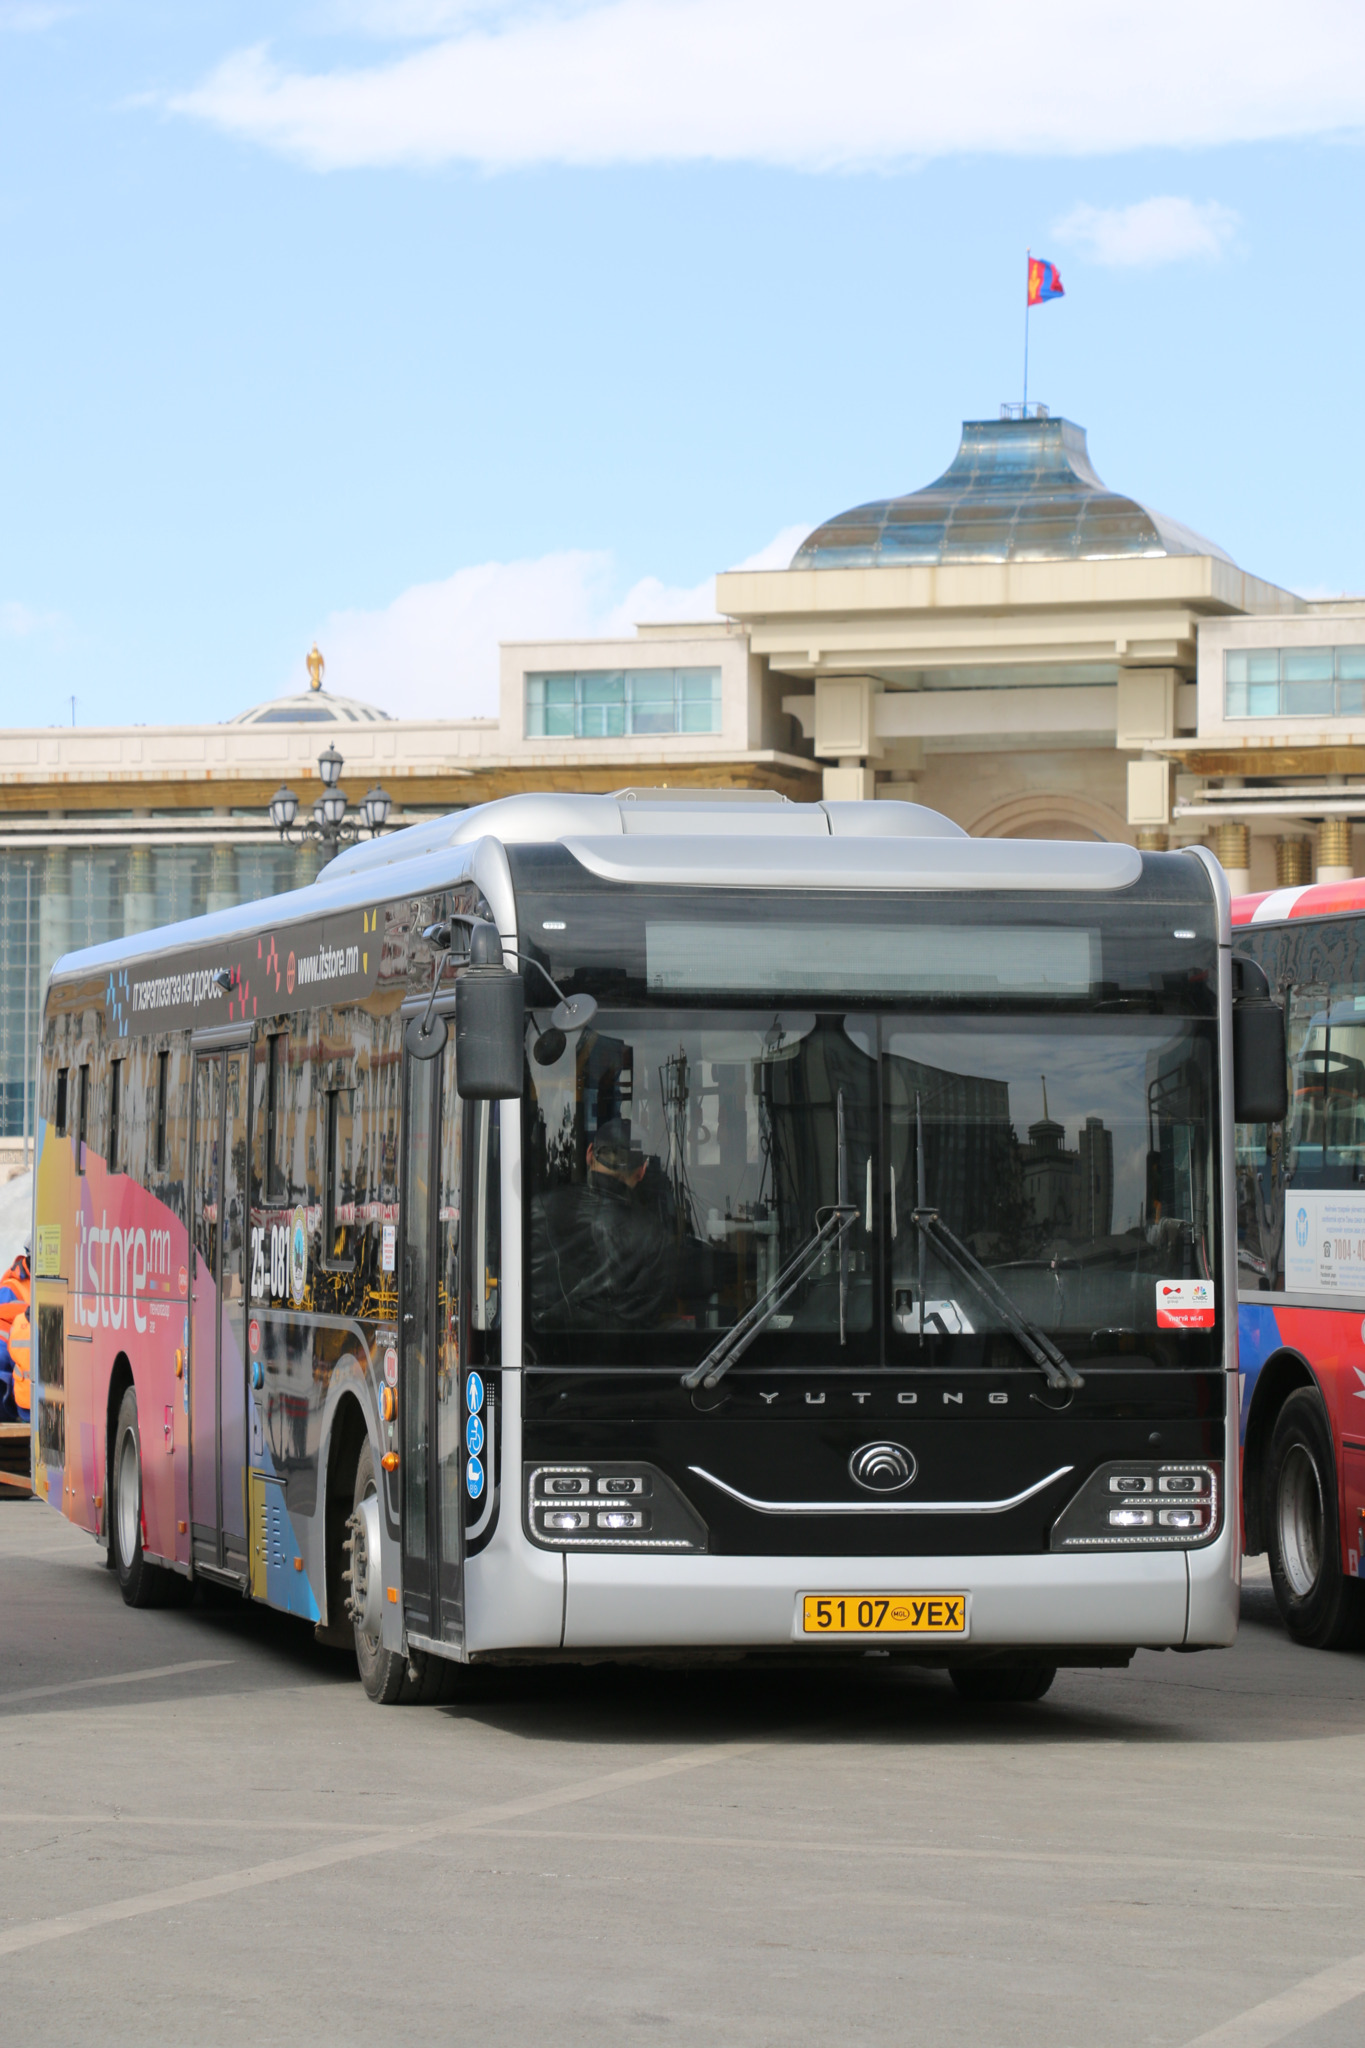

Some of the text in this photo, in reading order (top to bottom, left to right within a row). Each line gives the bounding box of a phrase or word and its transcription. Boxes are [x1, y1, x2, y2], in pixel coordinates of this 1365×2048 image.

[297, 945, 359, 985] www.itstore.mn
[181, 972, 195, 1004] НЭГ
[251, 1224, 290, 1298] 25-081
[759, 1392, 1008, 1404] YUTONG
[816, 1600, 846, 1628] 51
[857, 1600, 890, 1628] 07
[911, 1601, 959, 1626] УЕХ
